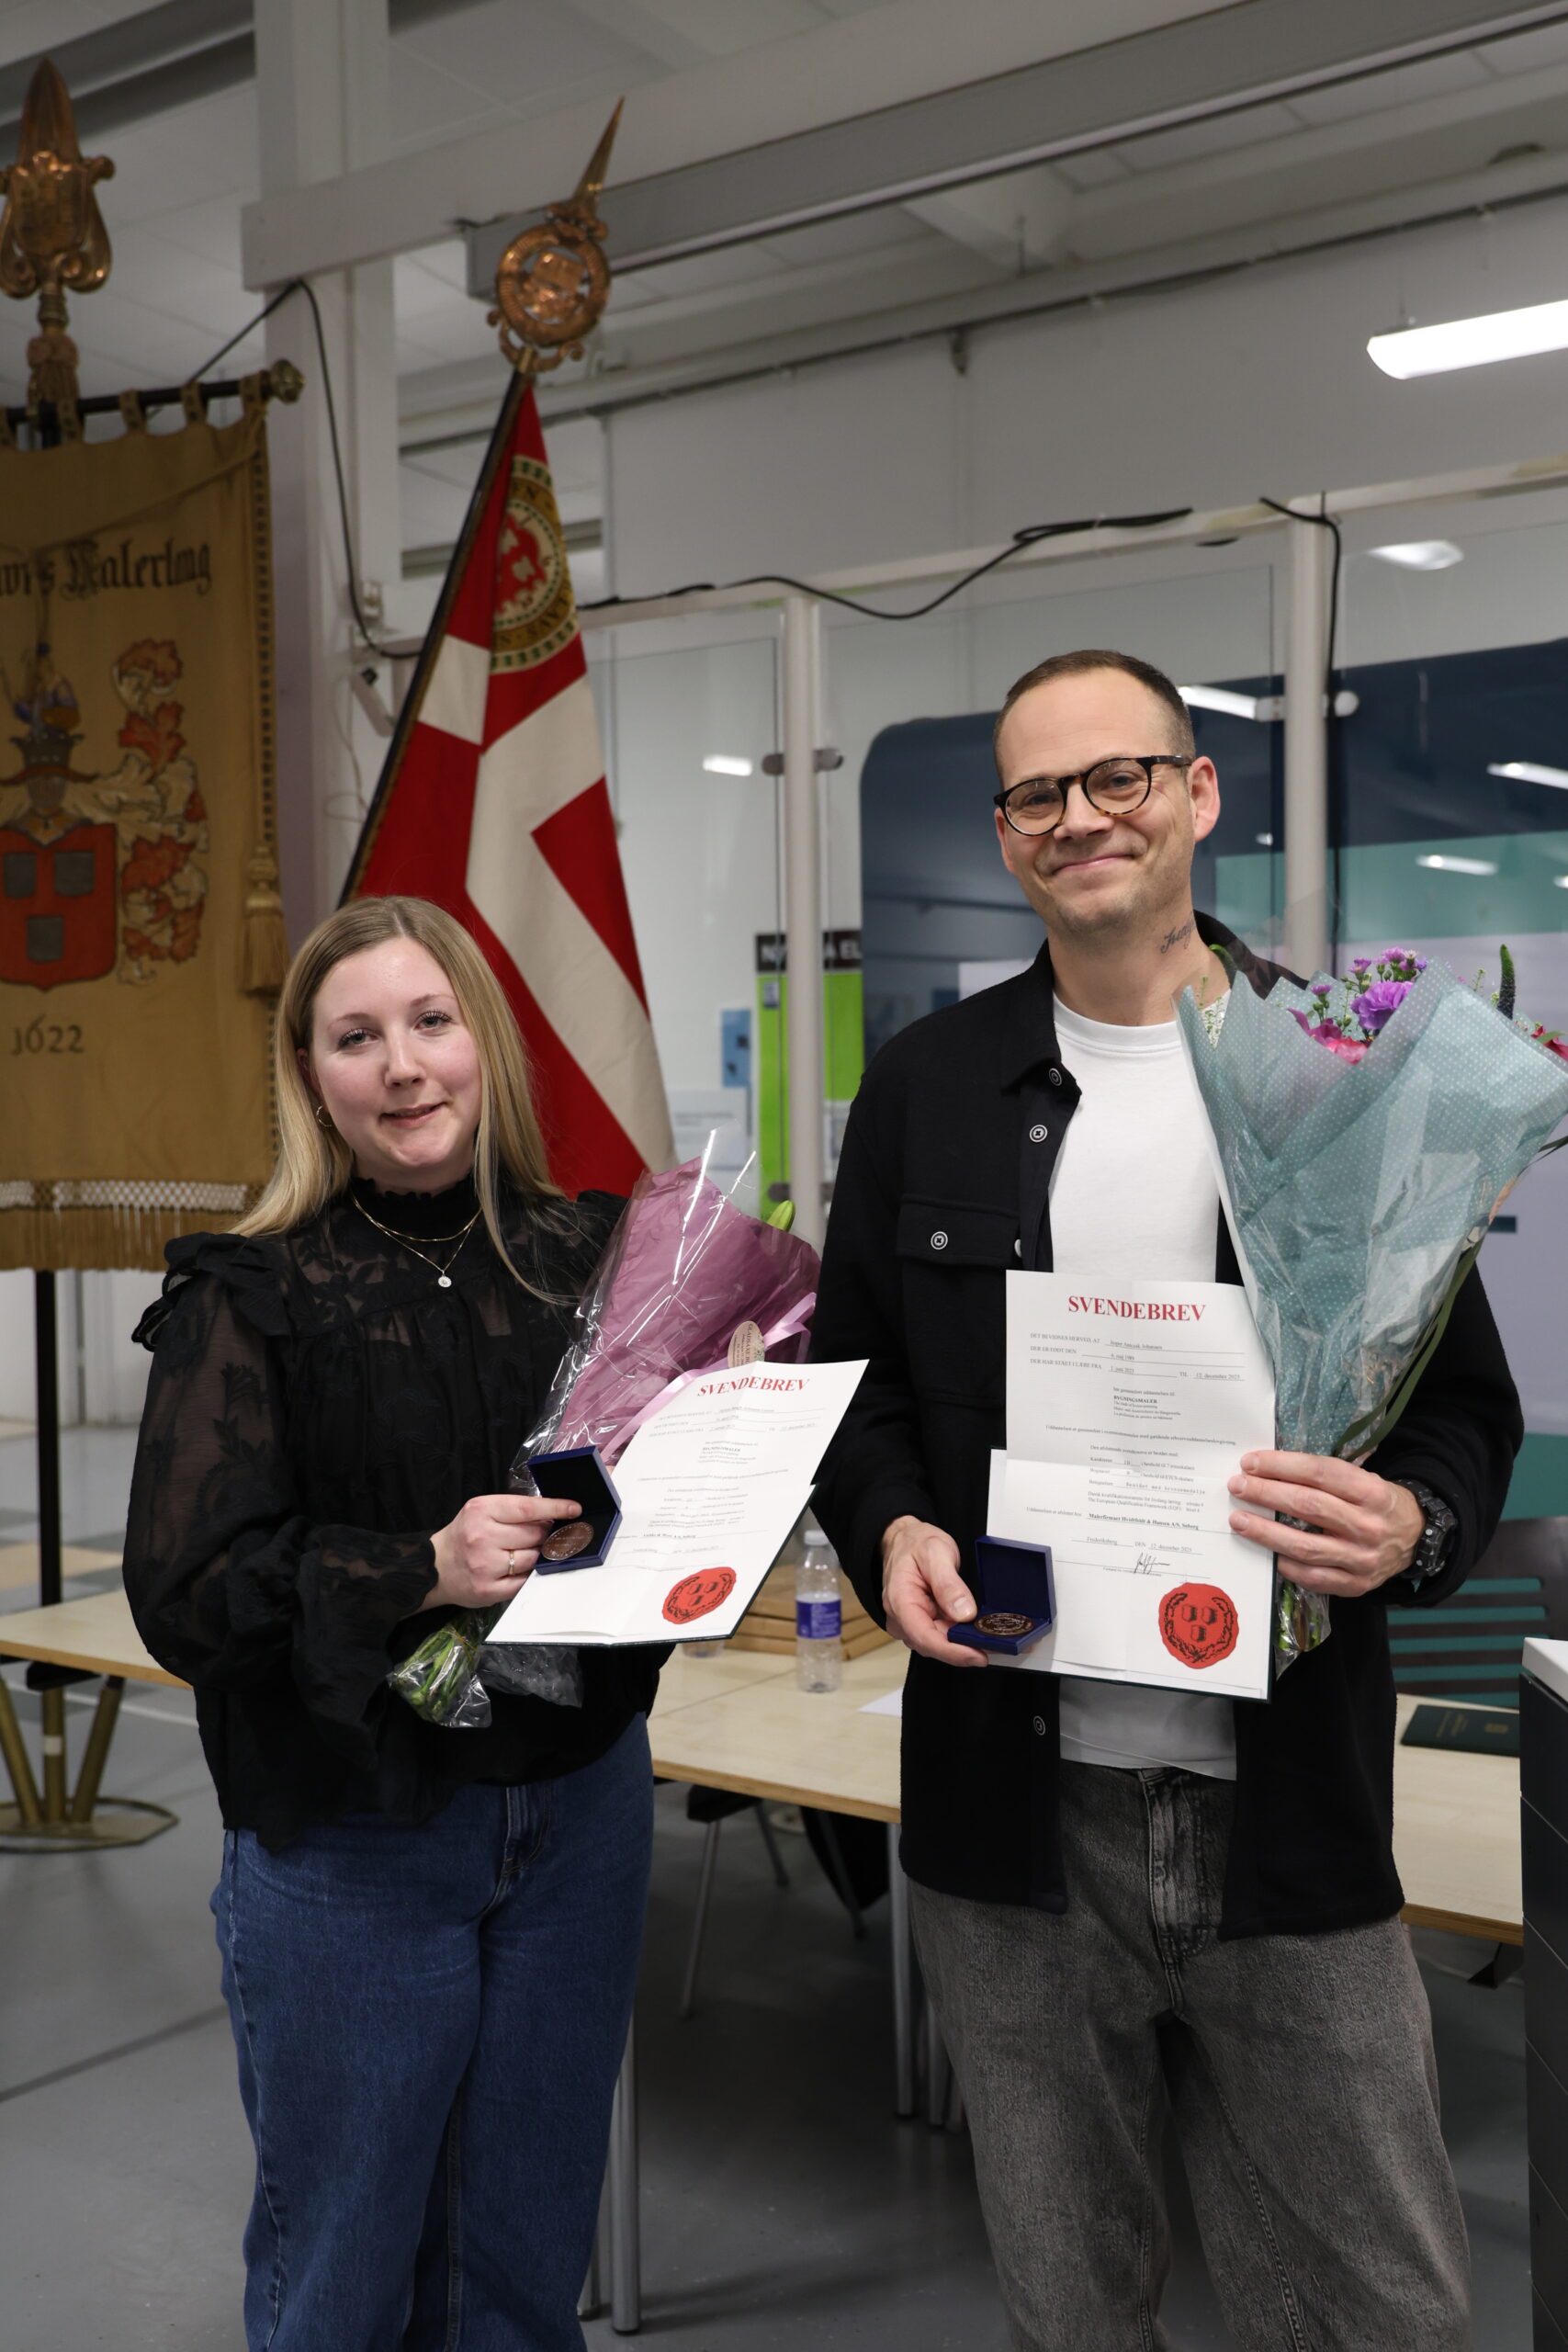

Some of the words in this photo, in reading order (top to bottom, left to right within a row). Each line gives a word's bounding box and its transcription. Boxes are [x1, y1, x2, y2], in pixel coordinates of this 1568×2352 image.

[10, 1012, 85, 1057] 1622
[1067, 1295, 1207, 1322] SVENDEBREV
[697, 1376, 810, 1396] SVENDEBREV
